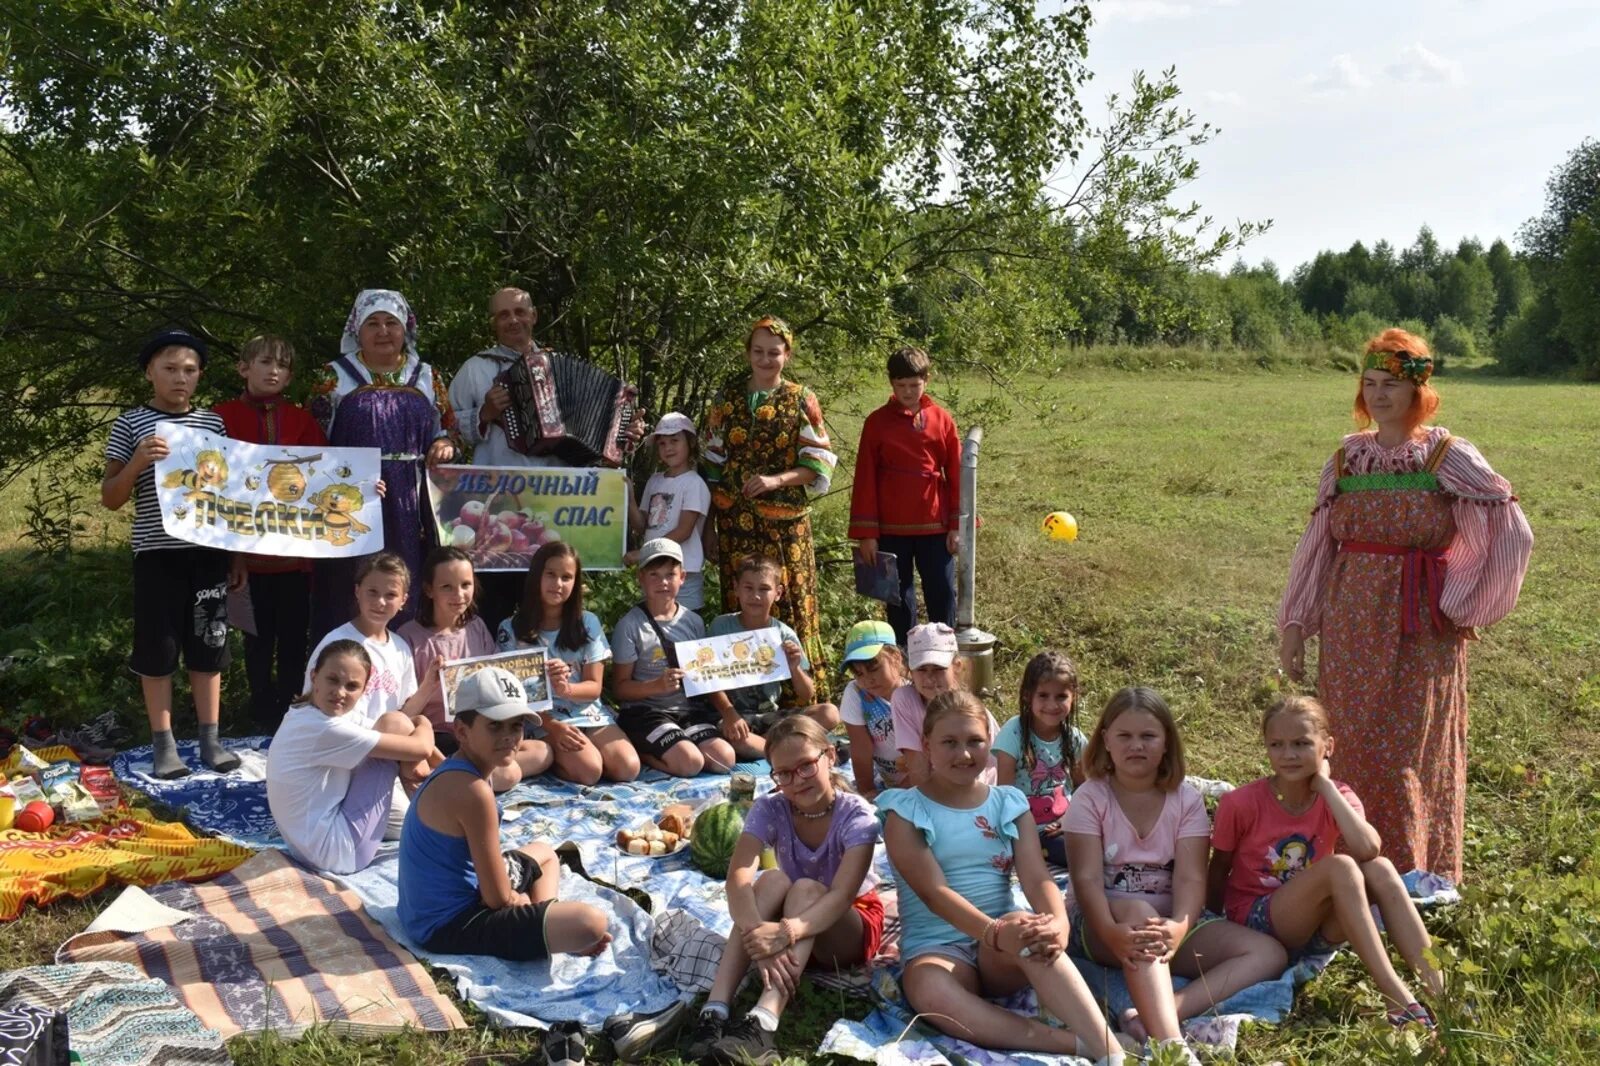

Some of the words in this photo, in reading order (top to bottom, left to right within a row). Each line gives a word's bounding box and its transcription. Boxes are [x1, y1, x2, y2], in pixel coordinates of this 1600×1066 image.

[455, 470, 600, 497] ЯБЛОЧНЫЙ
[195, 490, 326, 541] ПЧЕЛКИ
[553, 505, 615, 527] СПАС
[500, 678, 521, 698] LA
